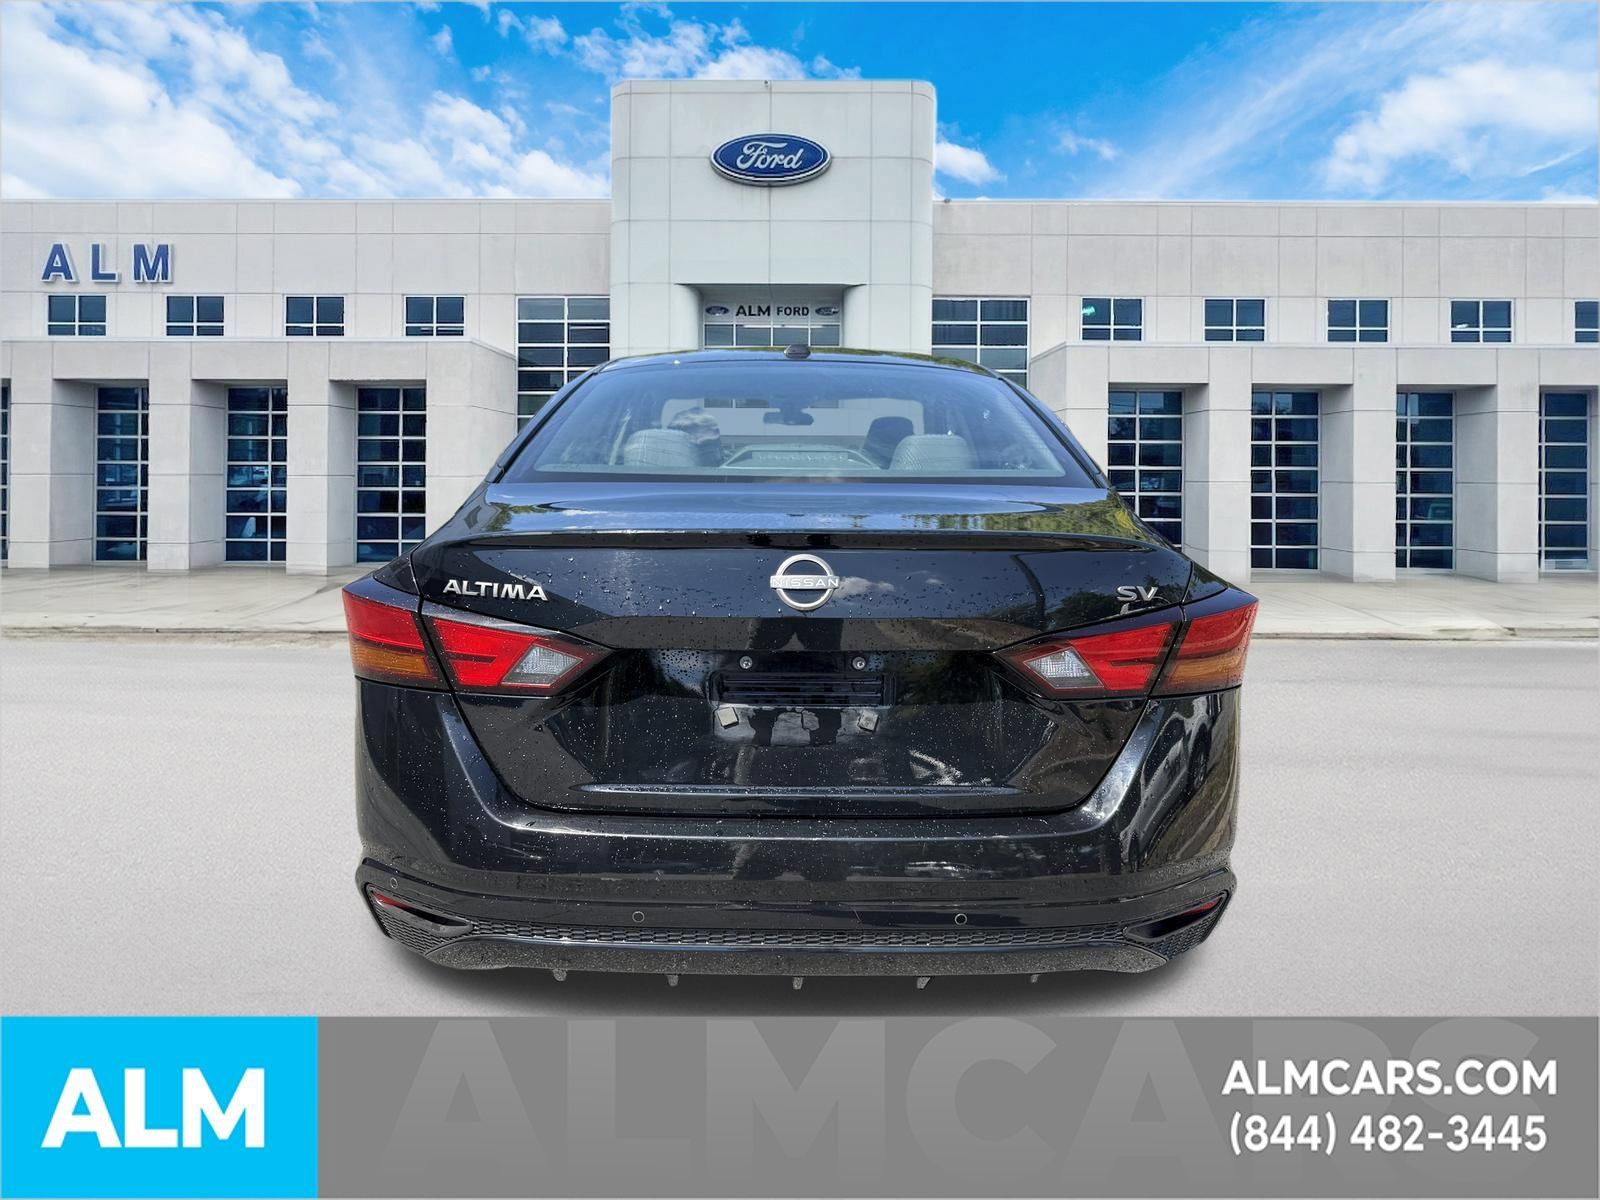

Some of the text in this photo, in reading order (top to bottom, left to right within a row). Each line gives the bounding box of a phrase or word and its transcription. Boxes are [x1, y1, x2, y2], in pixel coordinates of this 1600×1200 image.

[735, 141, 804, 169] Ford
[41, 242, 172, 283] ALM
[735, 305, 771, 317] ALM
[776, 306, 810, 316] FORD
[442, 579, 549, 601] ALTIMA
[772, 578, 839, 587] NISSAN
[1116, 585, 1159, 601] SV
